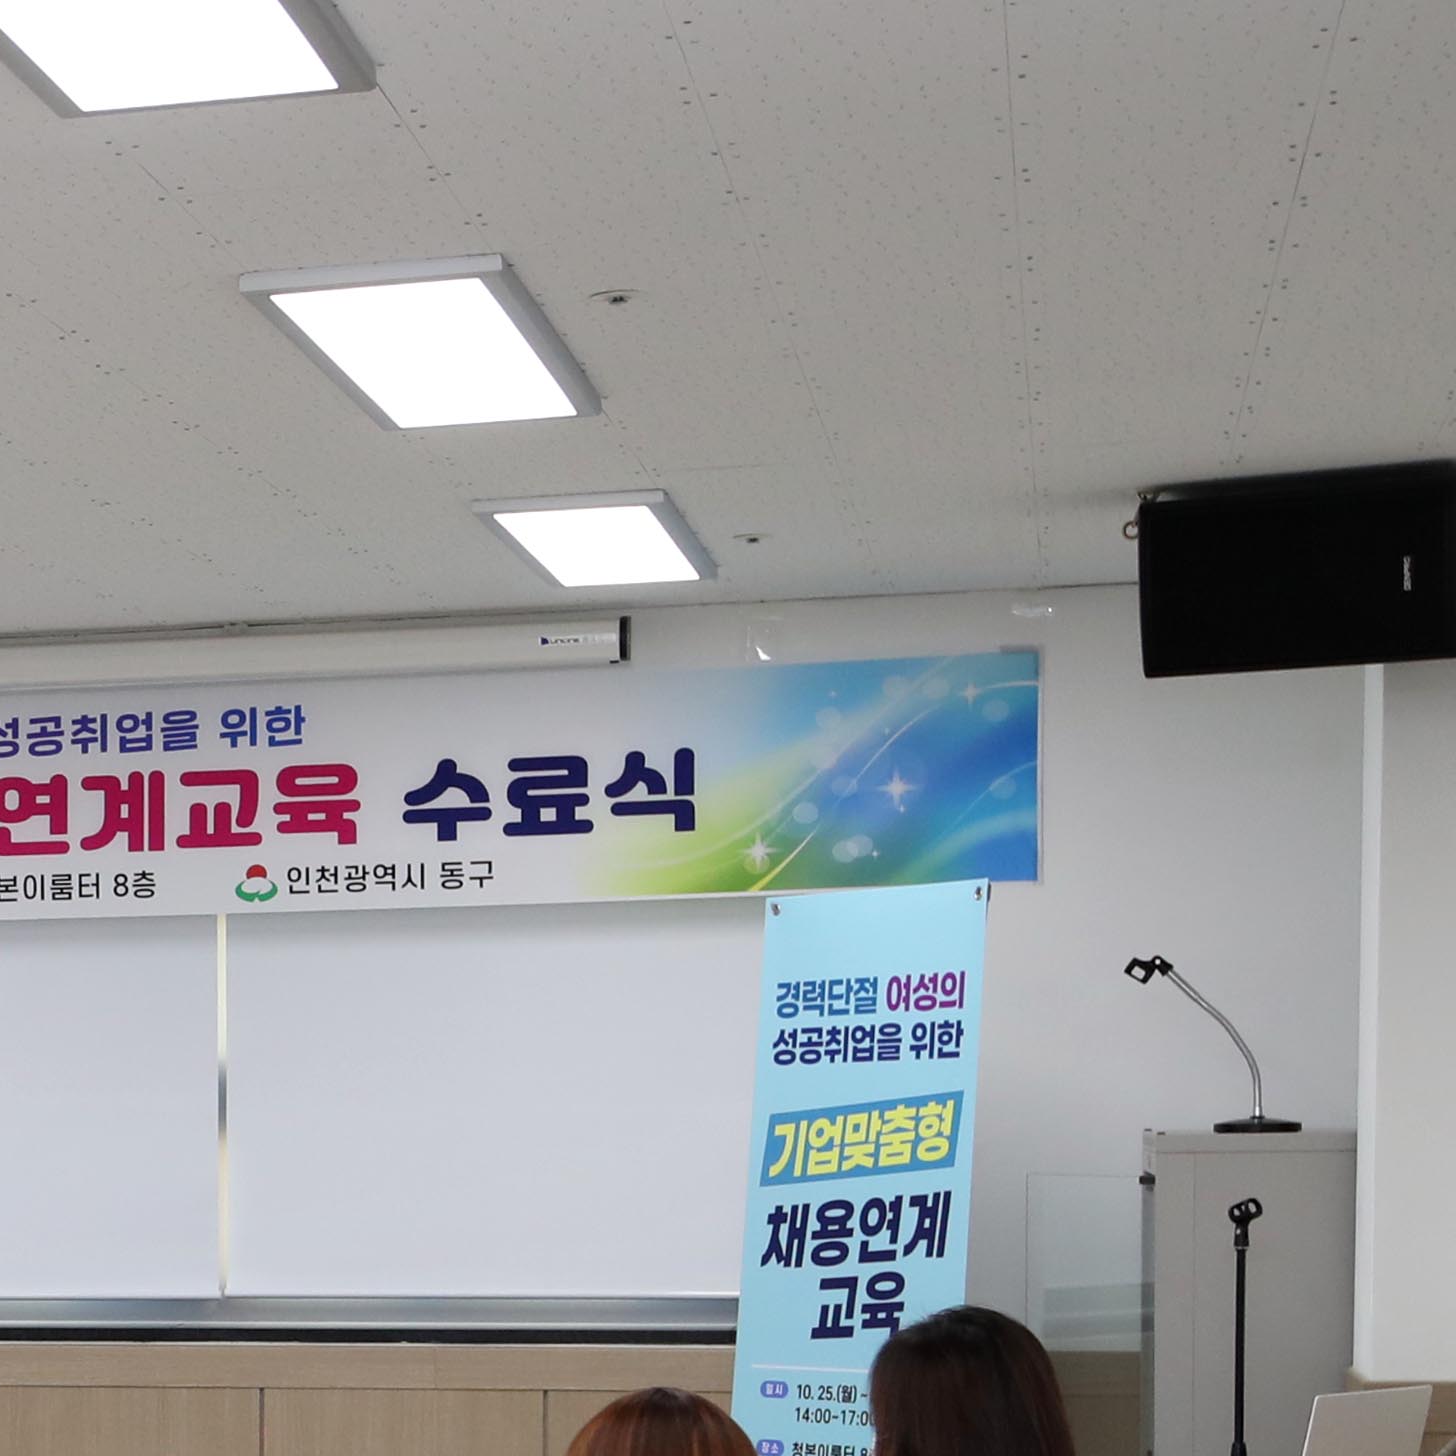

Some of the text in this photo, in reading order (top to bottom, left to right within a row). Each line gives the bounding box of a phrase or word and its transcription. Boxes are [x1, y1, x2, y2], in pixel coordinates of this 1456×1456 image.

[218, 705, 306, 750] 위한
[402, 747, 696, 842] 수료식
[113, 871, 157, 900] 8층
[285, 860, 495, 895] 인천광역시 동구
[775, 971, 967, 1019] 경력단절 여성의
[771, 1019, 965, 1067] 성공취업을 위한
[768, 1099, 955, 1177] 기업맞춤형
[759, 1190, 952, 1270] 채용연계
[810, 1270, 907, 1340] 교육
